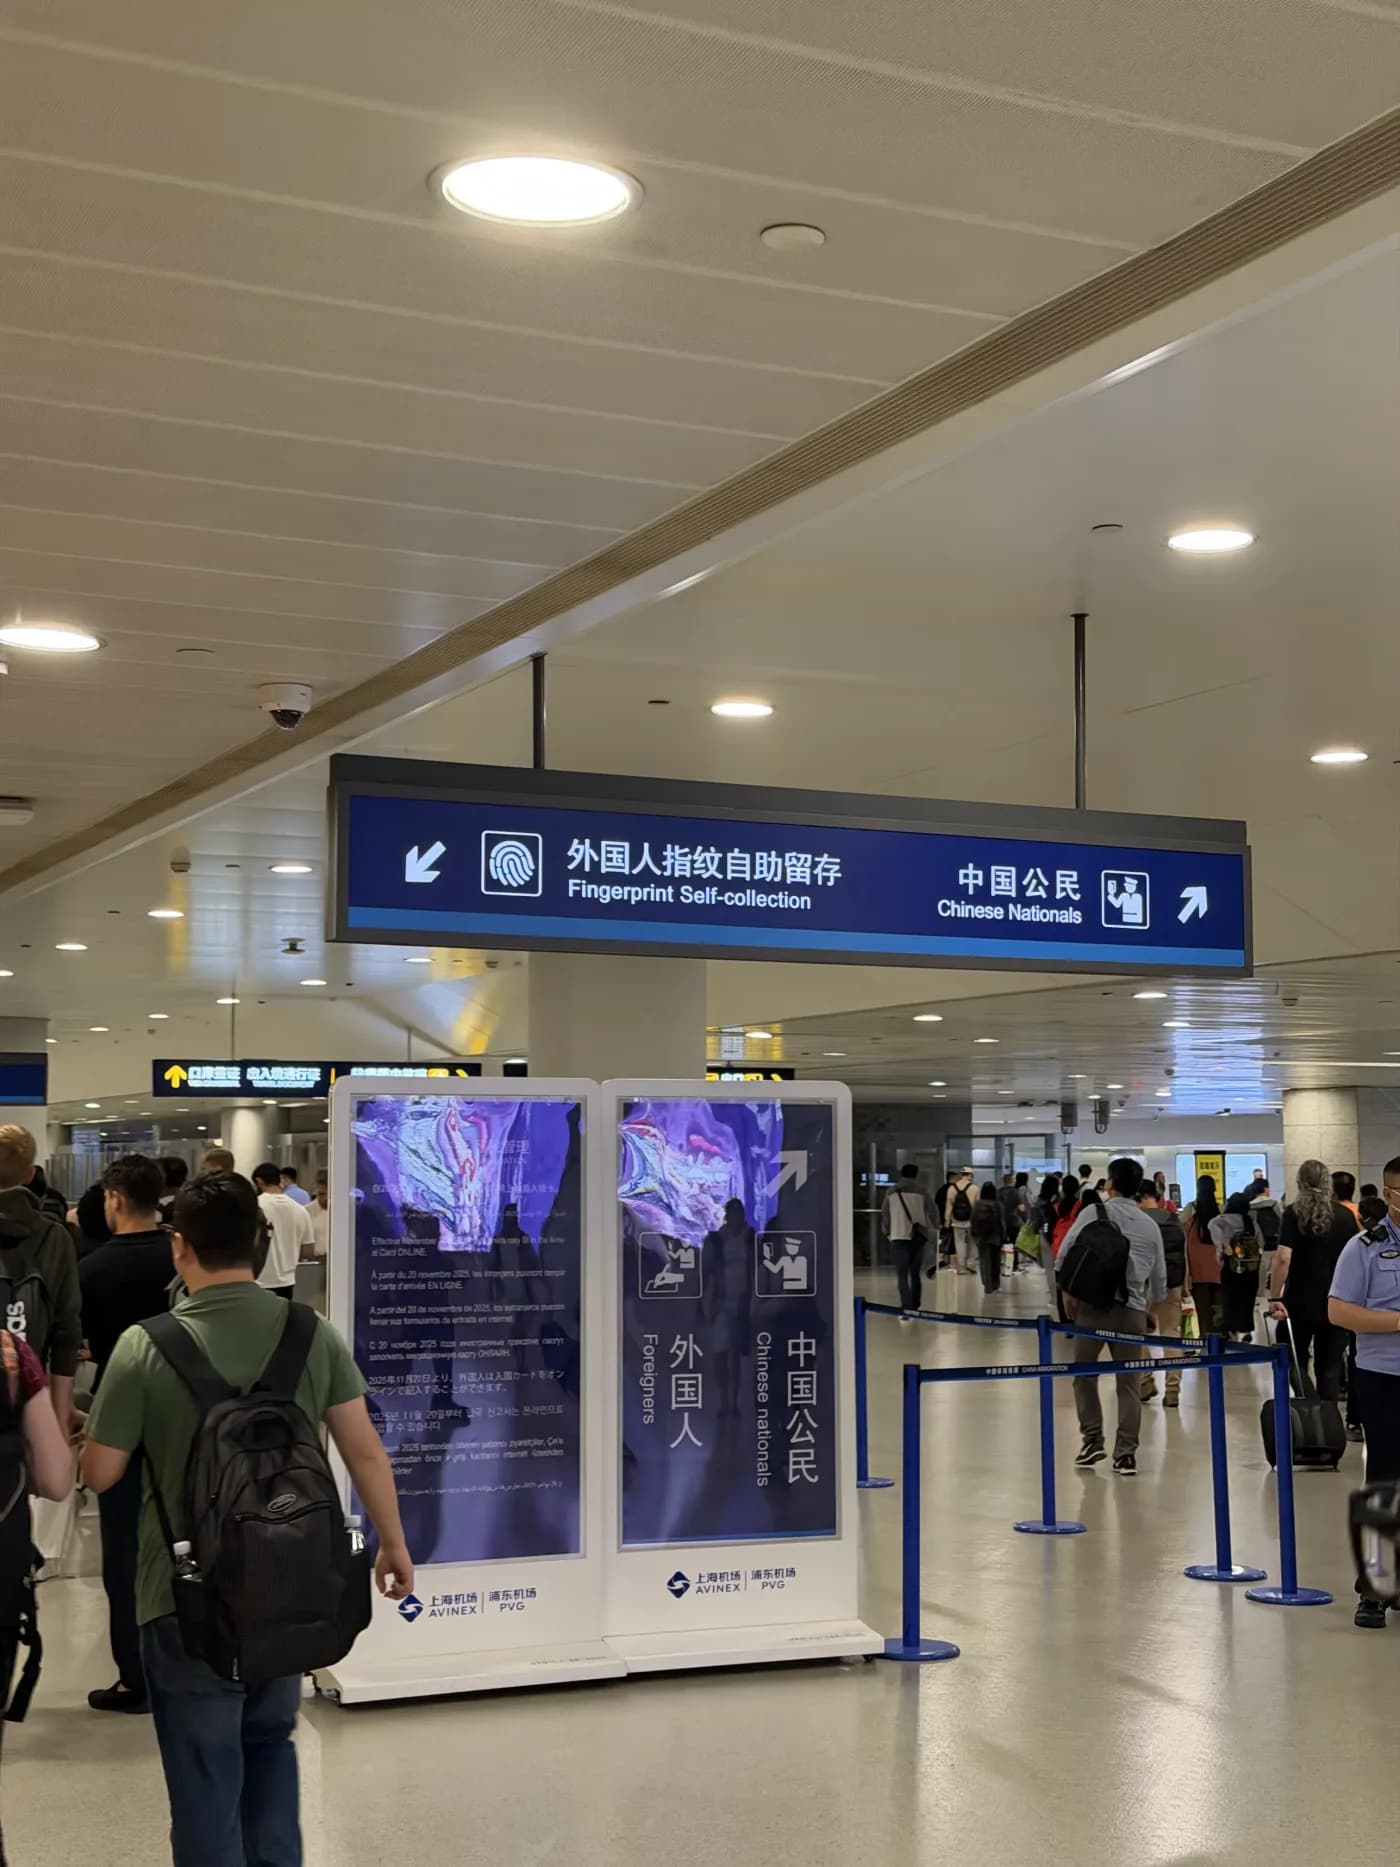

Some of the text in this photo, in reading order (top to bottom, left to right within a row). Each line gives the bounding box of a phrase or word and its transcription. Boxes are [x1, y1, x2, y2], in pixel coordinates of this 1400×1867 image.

[567, 838, 842, 887] 外国人指纹自助留存
[568, 879, 812, 910] Fingerprint Self-collection
[958, 862, 1081, 901] 中国公民
[937, 899, 1082, 924] Chinese Nationals
[639, 1334, 659, 1424] Foreigners
[669, 1333, 704, 1448] 外国人
[756, 1331, 772, 1487] Chinese nationals
[786, 1331, 819, 1484] 中国公民
[695, 1567, 796, 1584] 上海机场 浦东机场
[695, 1580, 785, 1594] AVINEX PVG
[428, 1587, 537, 1607] 上海机场 浦东机场
[428, 1601, 525, 1618] AVINEX PVG
